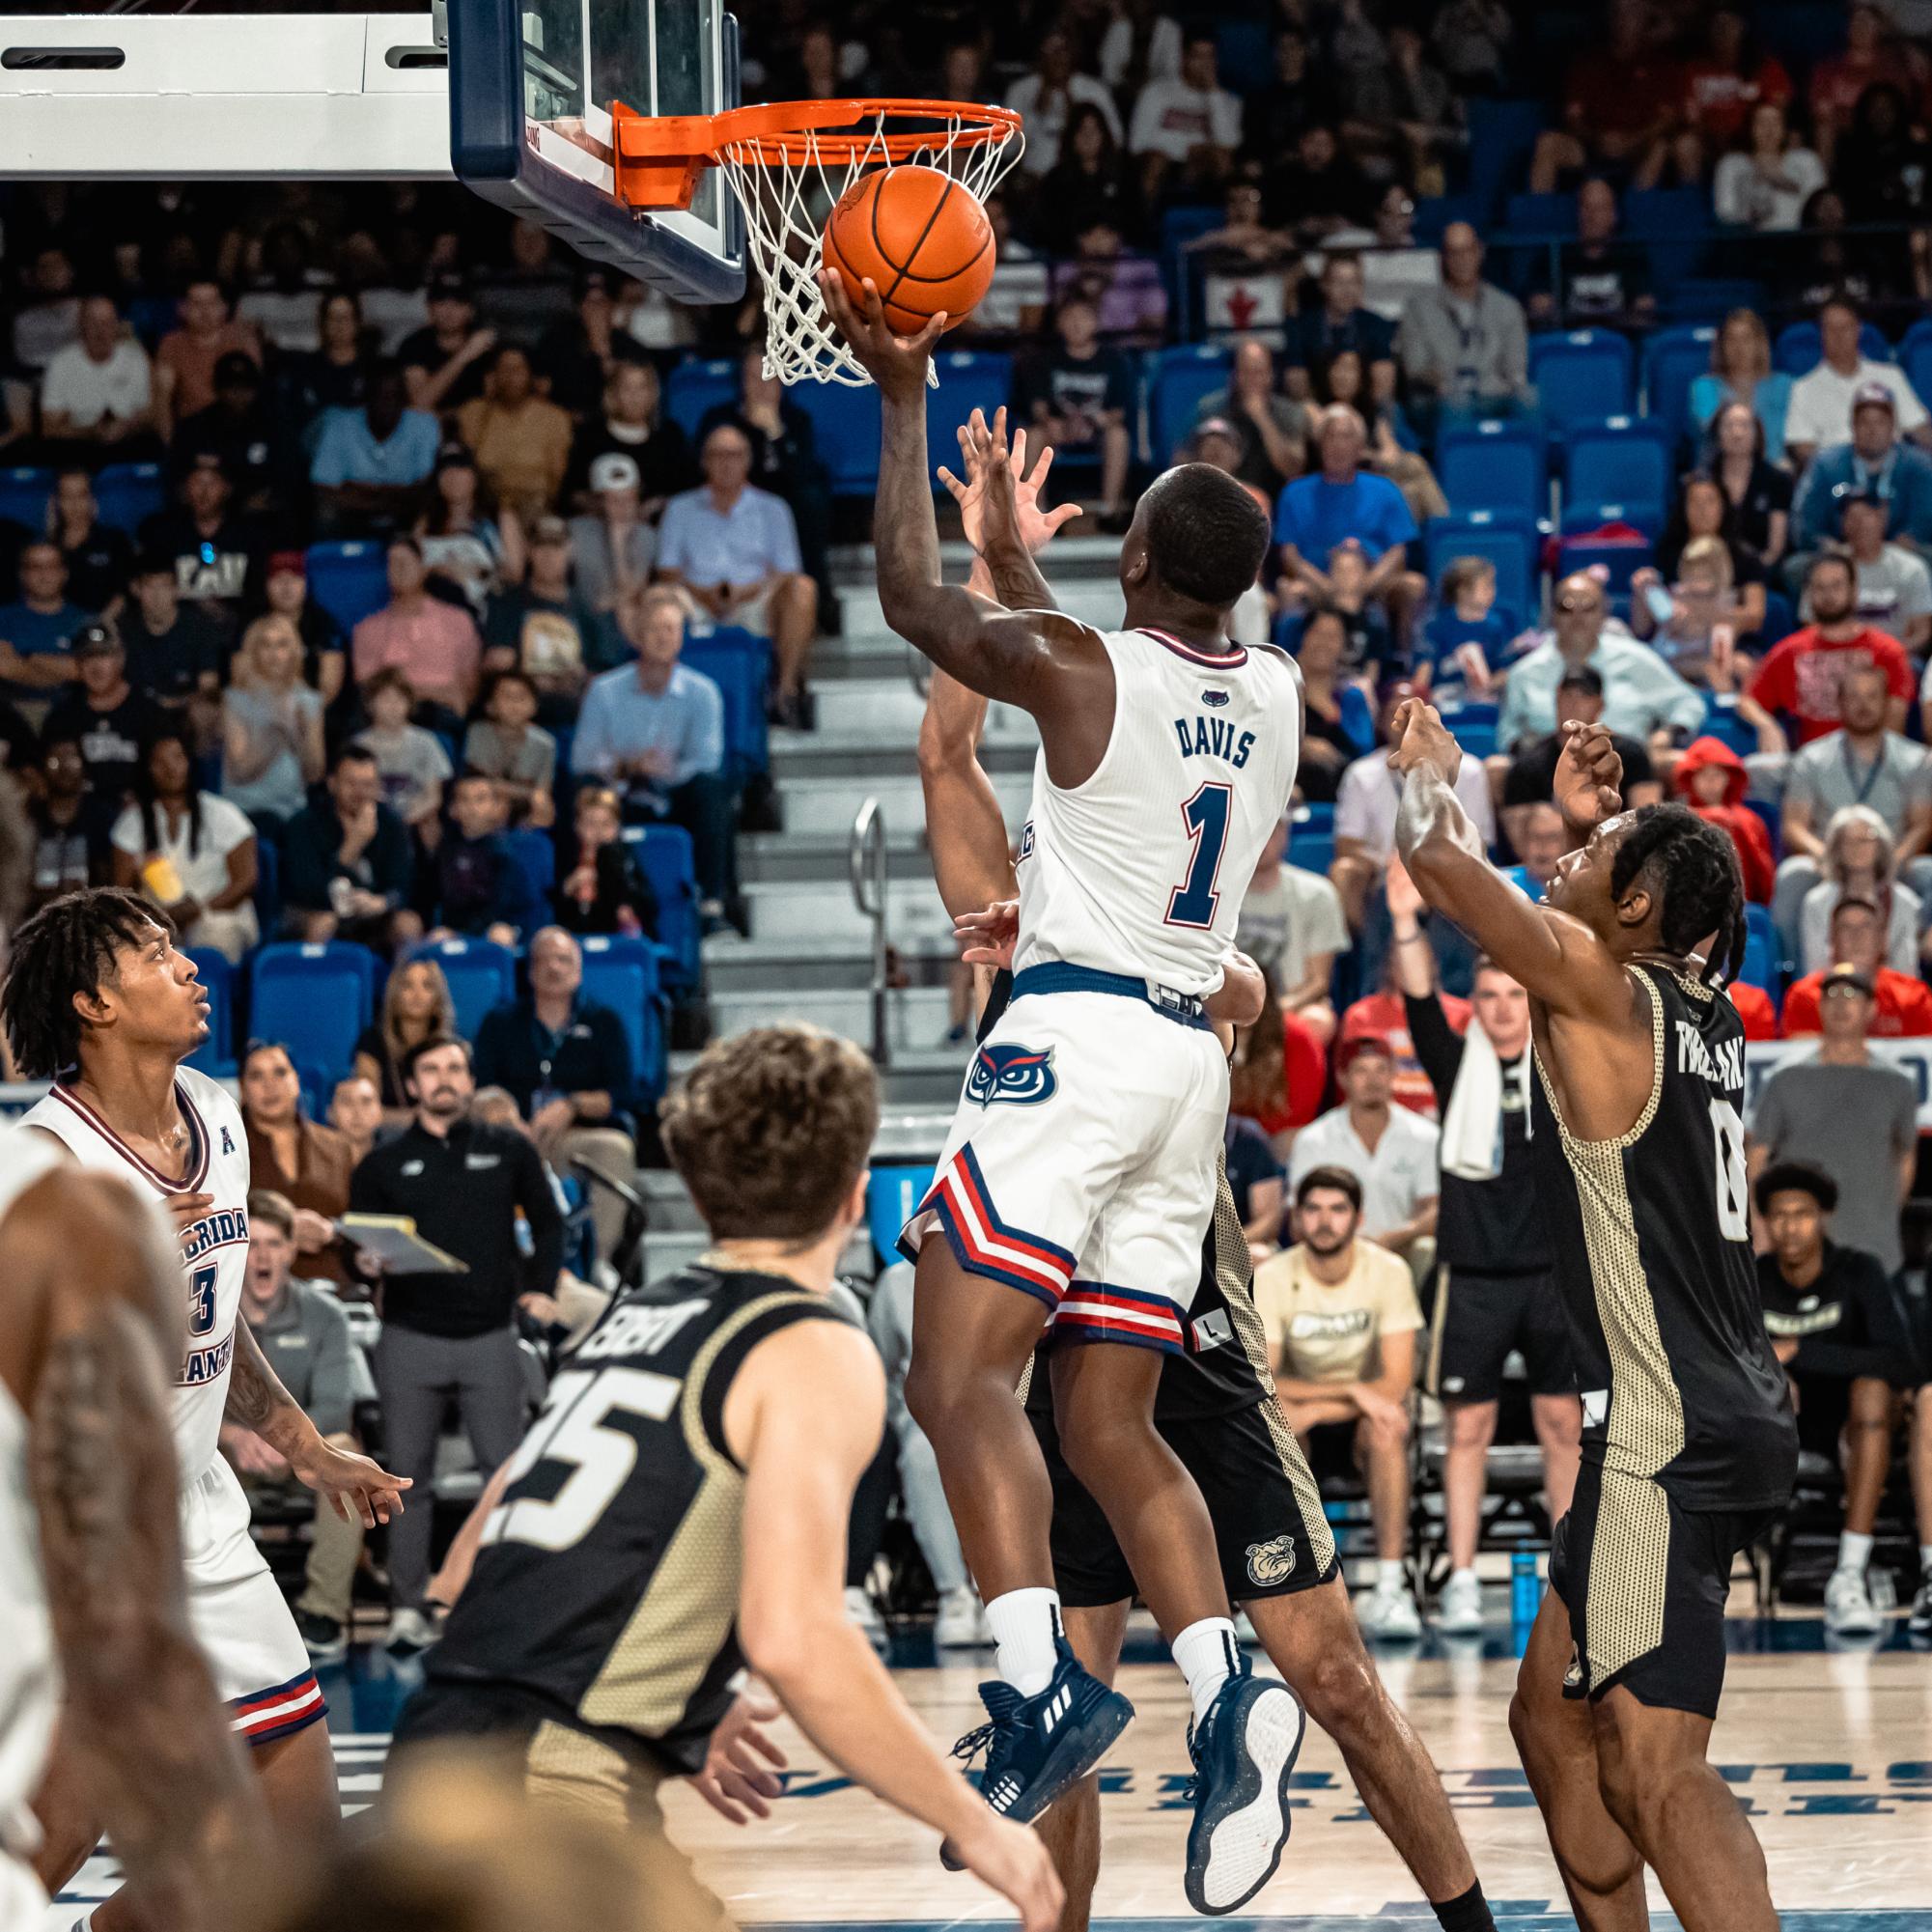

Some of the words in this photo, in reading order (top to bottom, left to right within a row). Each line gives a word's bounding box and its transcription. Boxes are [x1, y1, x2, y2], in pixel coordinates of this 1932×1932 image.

[1174, 716, 1256, 770] DAVIS
[1163, 780, 1232, 931] 1
[1708, 1097, 1749, 1242] 0
[188, 1261, 218, 1337] 3
[1203, 1320, 1218, 1338] L
